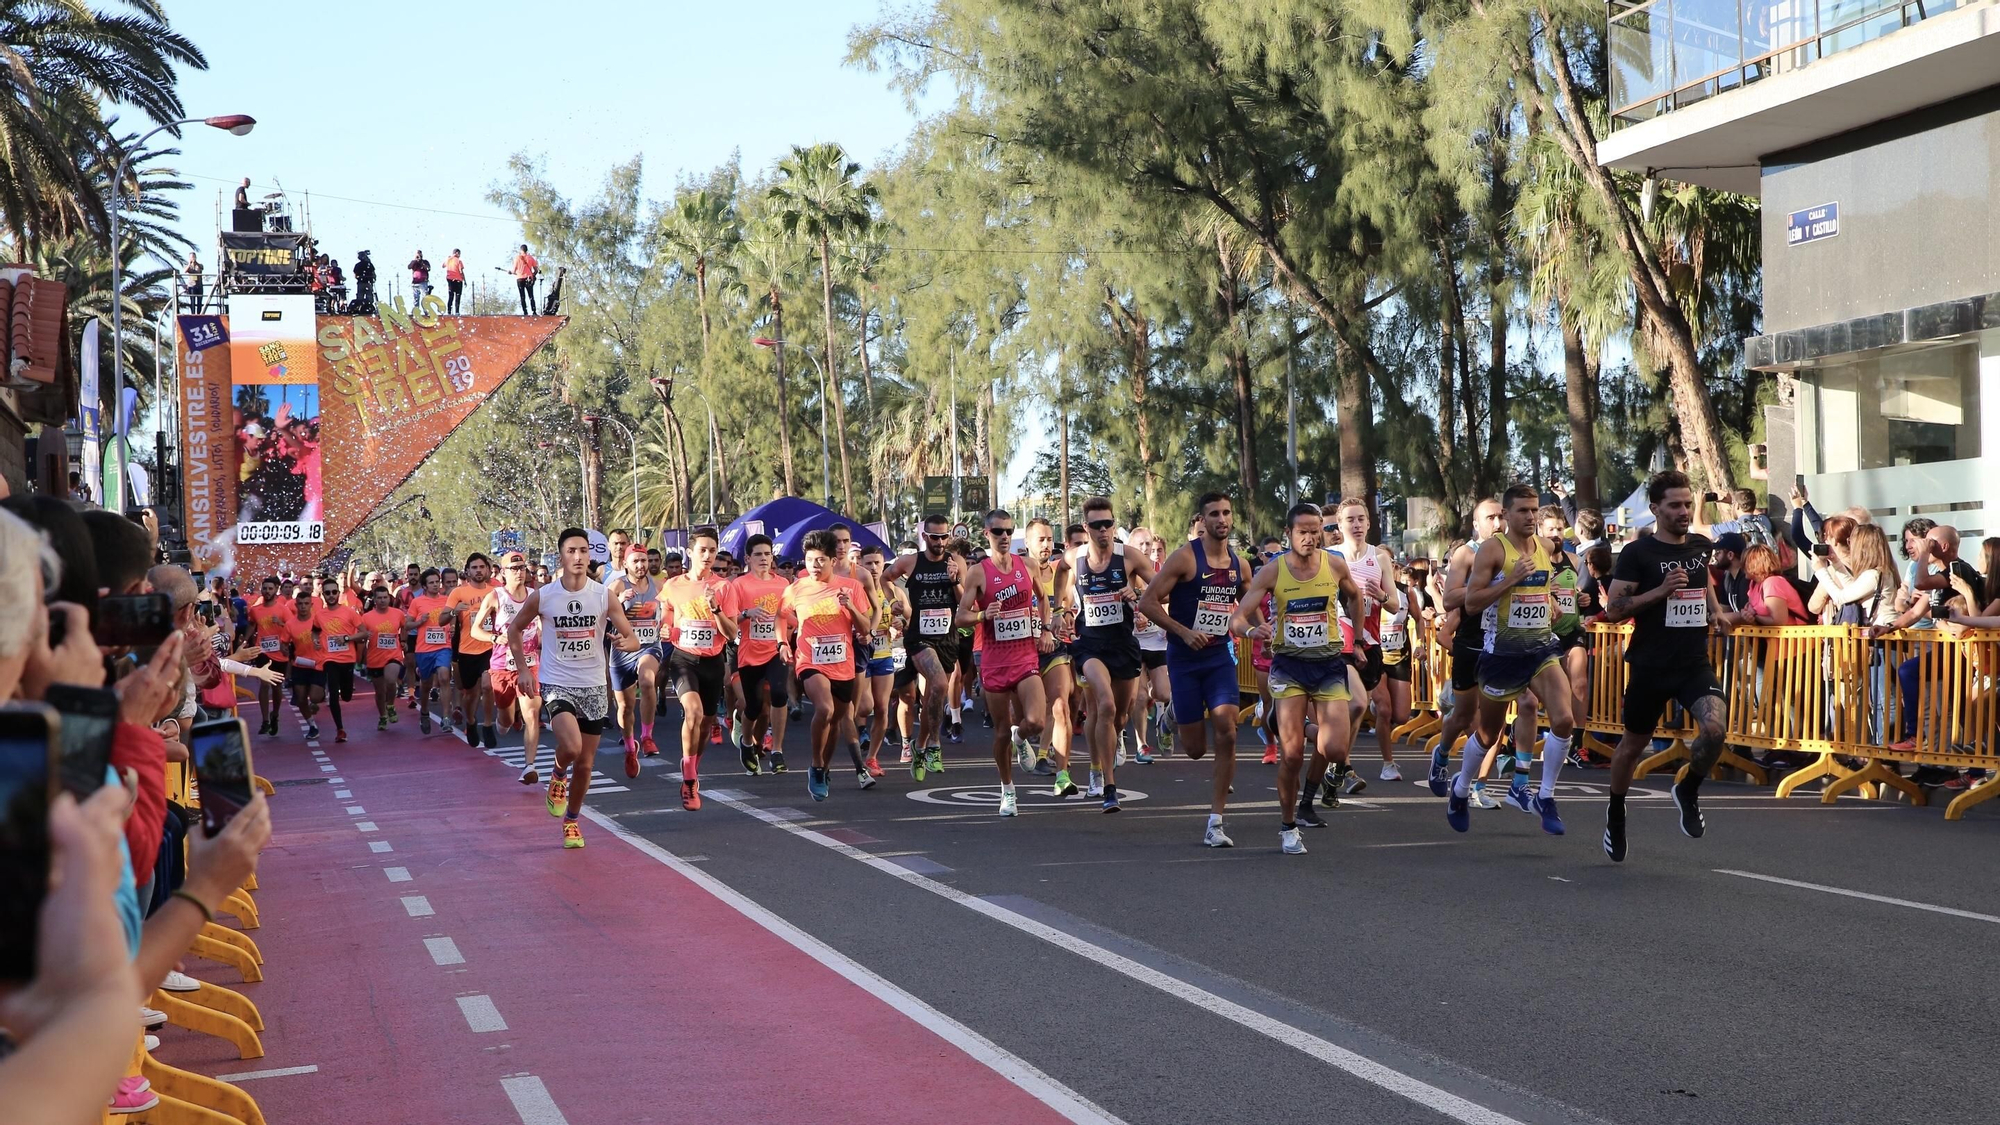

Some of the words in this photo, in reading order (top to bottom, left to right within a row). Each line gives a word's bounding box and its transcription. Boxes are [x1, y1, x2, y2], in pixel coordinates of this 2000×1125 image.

[1808, 209, 1826, 220] CALLE
[1805, 225, 1810, 238] Y
[1812, 219, 1837, 236] CASTILLO
[229, 248, 292, 265] TOPTIME
[190, 324, 214, 342] 31
[185, 350, 212, 558] SANSILVESTRE.ES
[589, 543, 606, 553] PS
[1660, 556, 1705, 573] POLUX
[995, 584, 1018, 601] 3COM
[1200, 586, 1237, 595] FUNDACIÓ
[1088, 604, 1117, 618] 9093
[1513, 606, 1545, 619] 4920
[1672, 604, 1704, 616] 10157
[923, 618, 949, 628] 7315
[998, 619, 1026, 633] 8491
[1199, 613, 1229, 627] 3251
[634, 628, 654, 637] 109
[685, 630, 712, 640] 1553
[1289, 625, 1323, 638] 3874
[1381, 633, 1399, 643] 977
[560, 640, 591, 652] 7456
[816, 644, 843, 657] 7445
